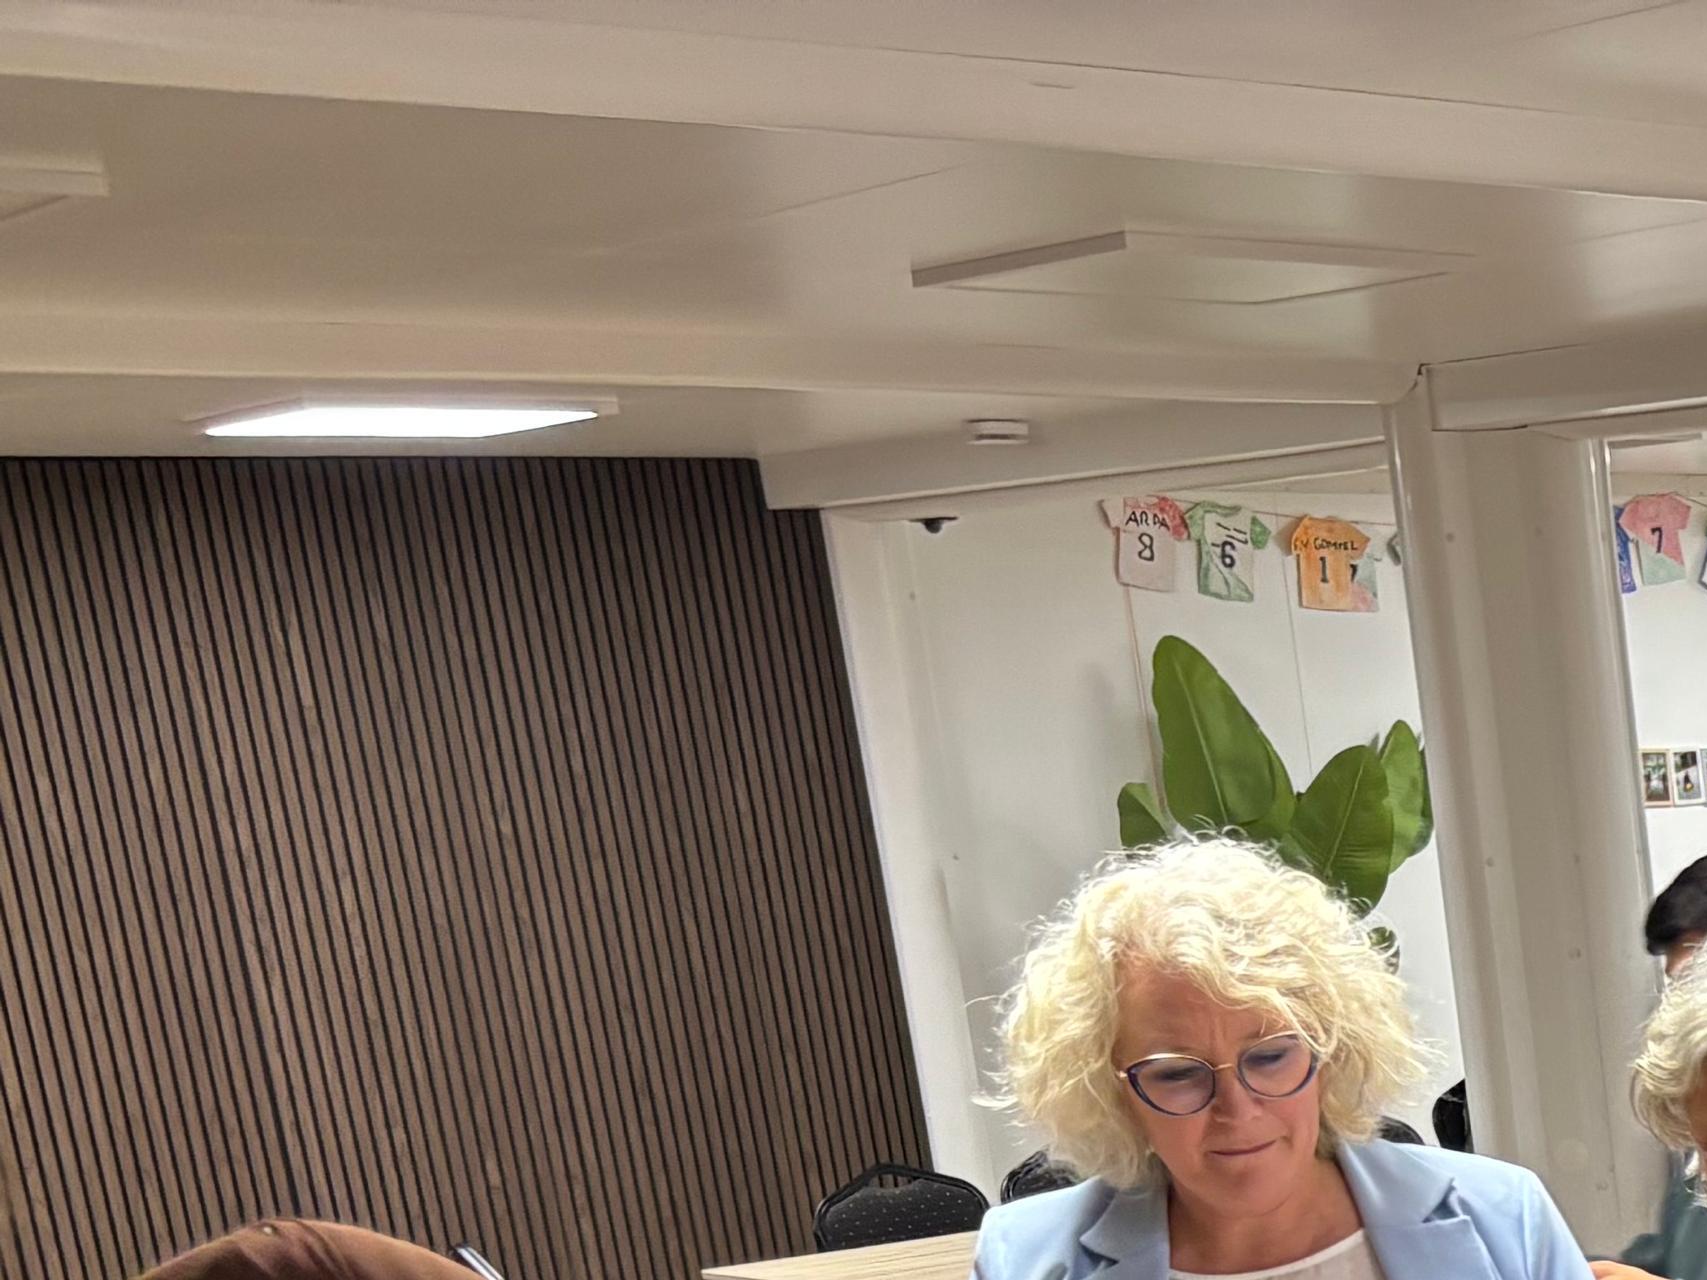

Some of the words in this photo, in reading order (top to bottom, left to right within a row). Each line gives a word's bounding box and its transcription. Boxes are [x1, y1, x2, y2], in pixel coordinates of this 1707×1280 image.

[1125, 510, 1170, 531] ARDA
[1138, 533, 1154, 562] 8
[1651, 527, 1663, 553] 7
[1221, 540, 1236, 568] 6
[1319, 556, 1329, 583] 1
